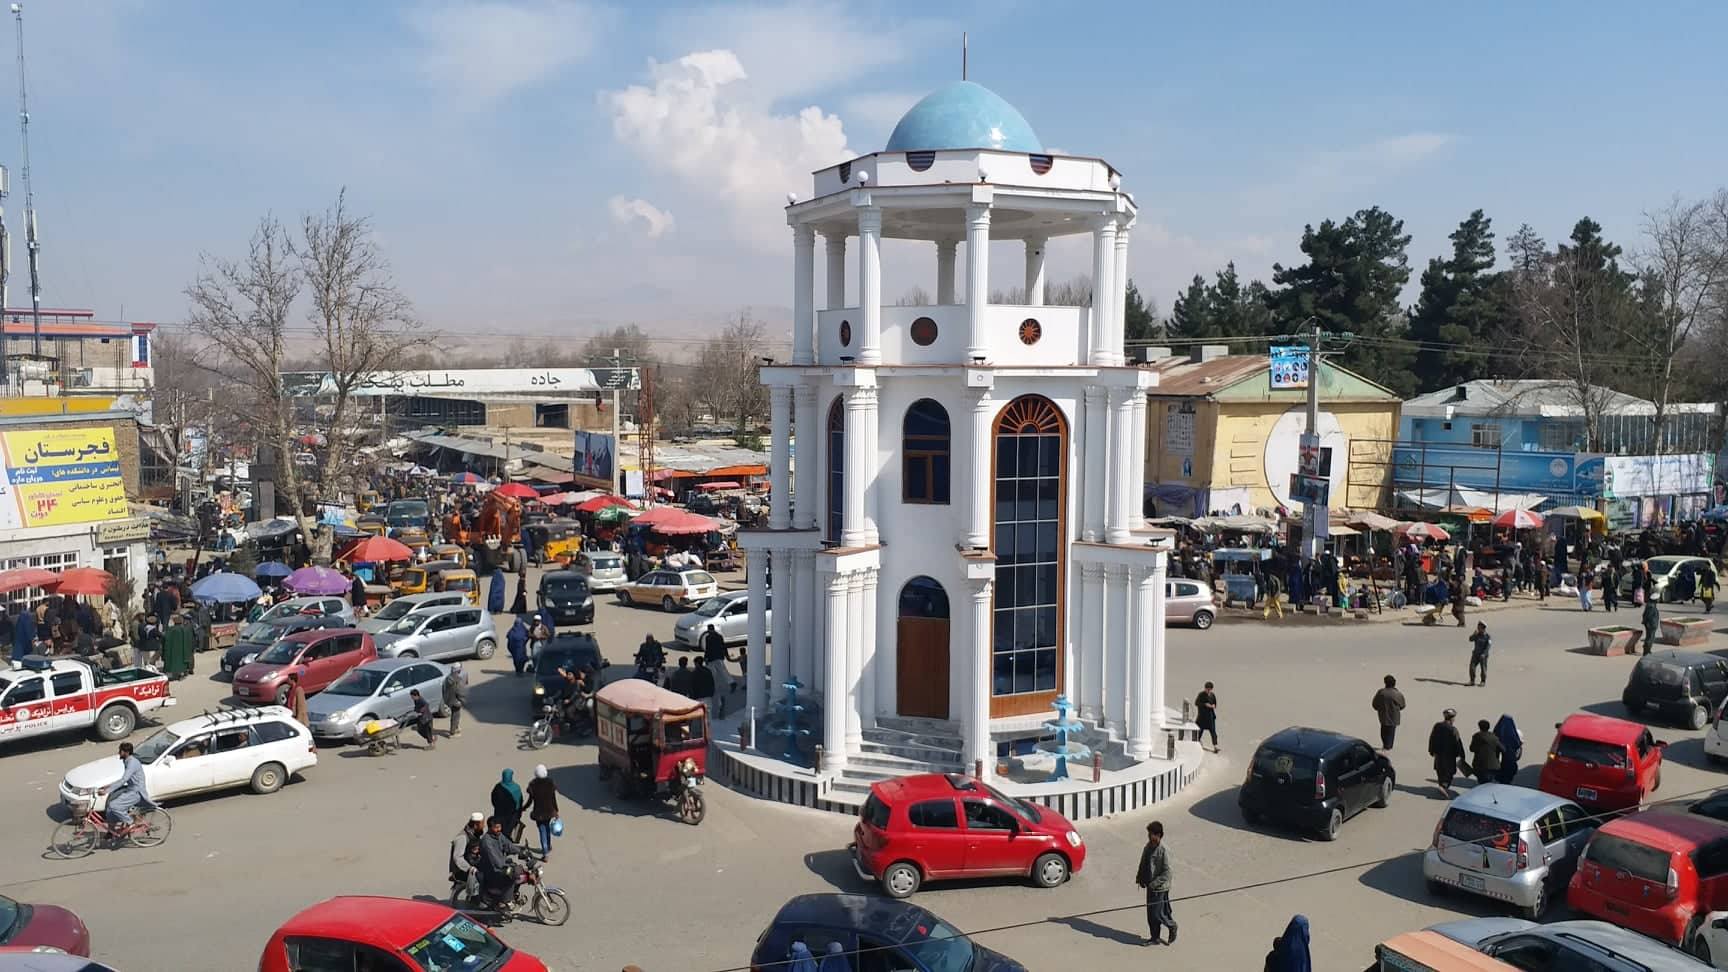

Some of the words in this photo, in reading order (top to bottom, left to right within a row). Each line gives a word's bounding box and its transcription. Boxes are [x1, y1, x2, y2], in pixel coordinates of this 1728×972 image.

[410, 373, 465, 392] مطلب
[531, 371, 561, 389] جاده
[24, 437, 110, 464] فجرستان
[138, 685, 160, 697] ترافیک
[31, 706, 51, 719] ترافیک
